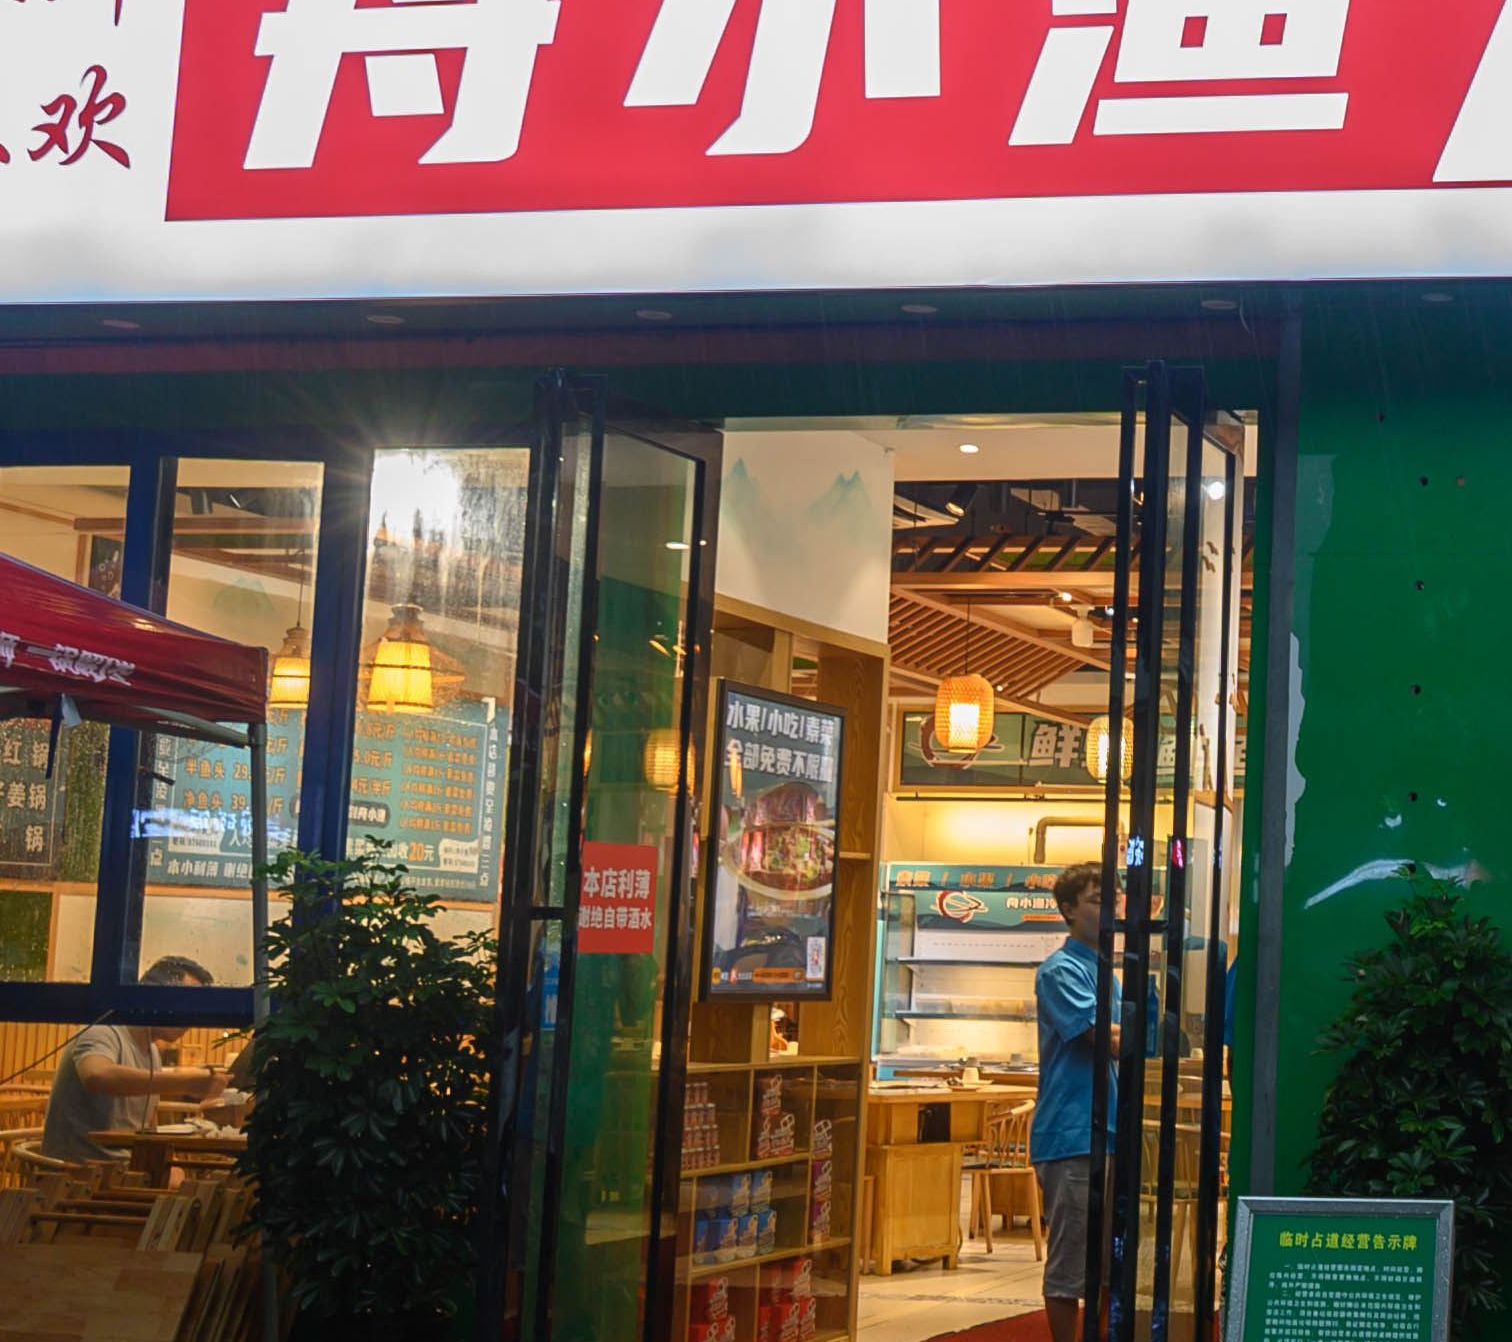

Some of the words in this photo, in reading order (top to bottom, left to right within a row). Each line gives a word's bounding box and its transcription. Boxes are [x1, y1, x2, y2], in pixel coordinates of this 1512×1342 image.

[584, 867, 652, 899] 本店利薄
[579, 905, 653, 929] 谢绝自带酒水
[1279, 1230, 1418, 1251] 临时占道经营告示牌
